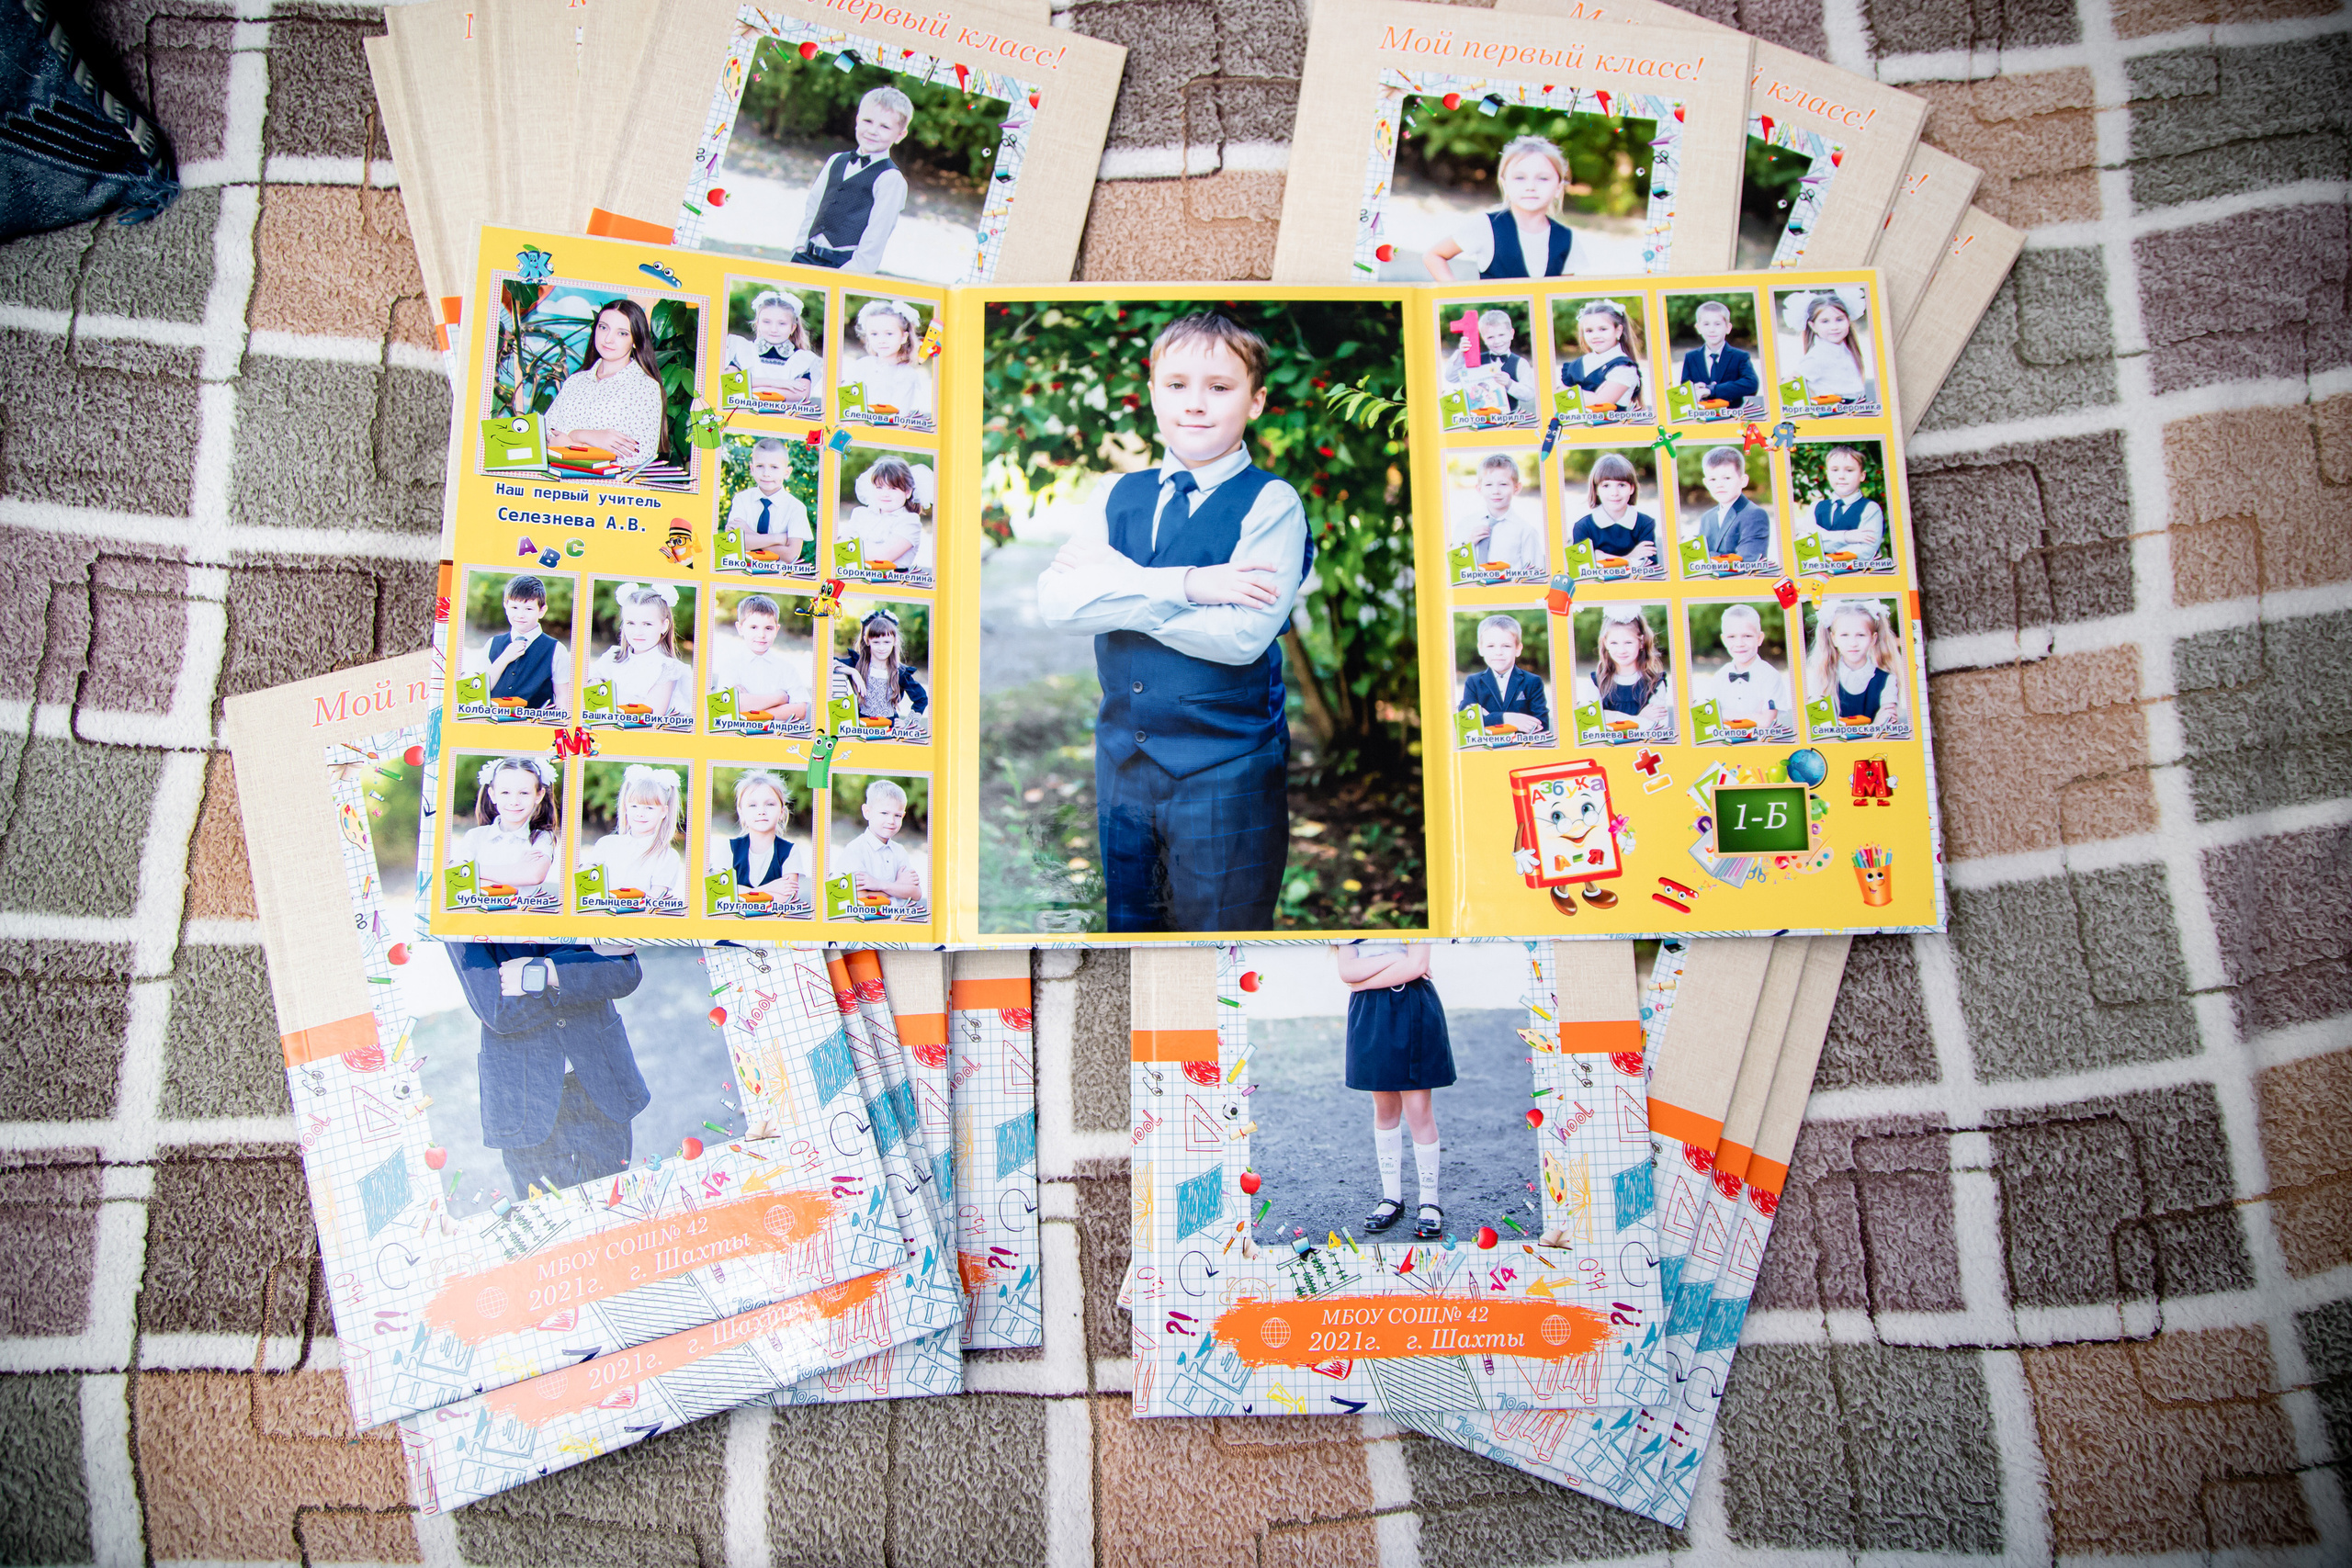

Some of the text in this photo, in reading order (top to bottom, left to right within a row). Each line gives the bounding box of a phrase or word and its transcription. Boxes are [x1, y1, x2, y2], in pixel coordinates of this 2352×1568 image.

[957, 27, 1067, 70] класс!
[1379, 26, 1704, 82] Мой первый класс!
[1767, 80, 1877, 131] класс!
[728, 397, 816, 413] Бондаренко Анна
[1781, 403, 1882, 414] Моргачева Вероника
[844, 410, 928, 426] Слепцова Полина
[1453, 413, 1526, 423] Глотов Кирилл
[1559, 411, 1654, 422] Филатова Вероника
[1688, 408, 1744, 418] Ершов Егор
[495, 483, 662, 508] Наш первый учитель
[498, 507, 647, 533] Селезнева А.В.
[722, 558, 810, 573] Евко Константин
[1734, 560, 1769, 570] Кирилл
[1853, 559, 1893, 569] Евгений
[837, 567, 933, 582] Сорокина Ангелина
[1461, 568, 1540, 580] Бирюков Никита
[1581, 566, 1655, 577] Донскова Вера
[312, 680, 396, 728] Мой
[458, 705, 568, 720] Колбасин Владимир
[582, 711, 695, 725] Башкатова Виктория
[769, 722, 806, 732] Андрей
[840, 726, 921, 738] Кравцова Алиса
[1713, 727, 1782, 738] Осипов Артем
[1812, 724, 1910, 735] Санжаровская Кира
[1465, 733, 1547, 744] Ткаченко Павел
[1582, 729, 1674, 740] Беляева Виктория
[1734, 802, 1788, 830] 1-Б
[457, 895, 549, 906] Чубченко Алена
[582, 897, 684, 908] Белынцева Ксения
[717, 901, 803, 913] Круглова Дарья
[847, 905, 917, 915] Попов Никита
[538, 1247, 602, 1281] МБОУ
[685, 1216, 709, 1235] 42
[529, 1232, 752, 1312] 2021г. г. Шахты
[1321, 1308, 1385, 1325] МБОУ
[1466, 1306, 1489, 1323] 42
[588, 1352, 662, 1391] 2021г.
[688, 1337, 705, 1354] г.
[711, 1300, 806, 1347] Шахты
[1308, 1328, 1526, 1352] 2021г. г. Шахты
